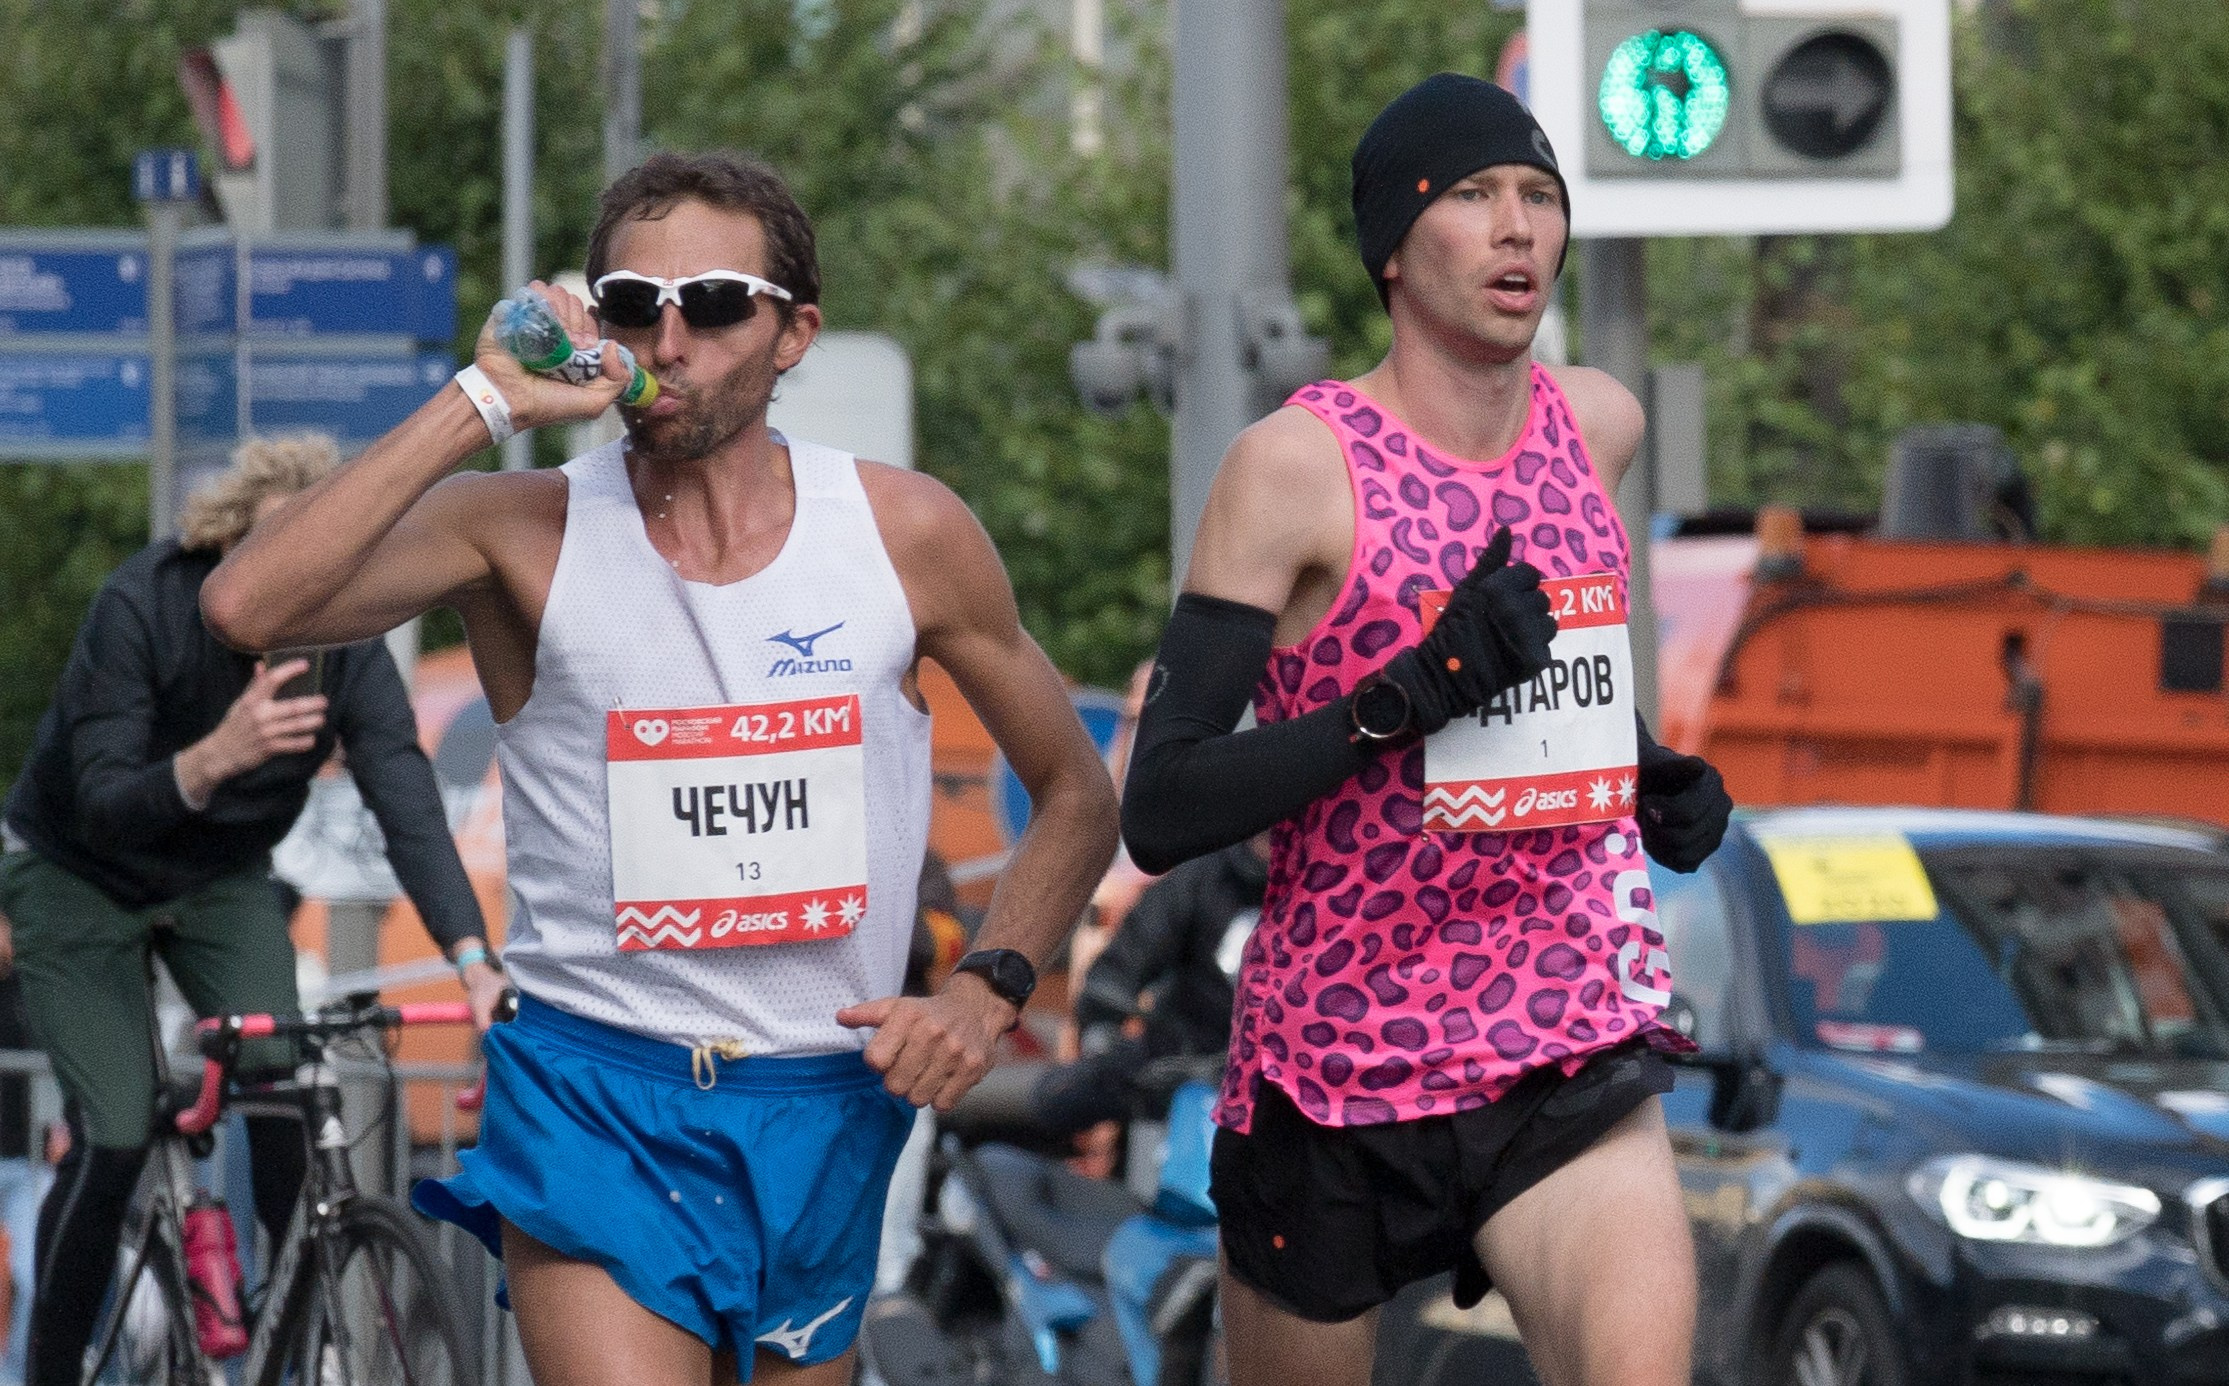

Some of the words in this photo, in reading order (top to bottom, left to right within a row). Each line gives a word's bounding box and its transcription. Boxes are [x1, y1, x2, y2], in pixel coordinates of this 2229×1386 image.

[1546, 588, 1577, 621] ,2
[1468, 654, 1614, 727] ДАРОВ
[730, 711, 796, 743] 42,2
[1541, 739, 1548, 758] 1
[672, 778, 809, 837] ЧЕЧУН
[1536, 789, 1578, 811] asics
[736, 861, 761, 881] 13
[736, 911, 789, 933] asics
